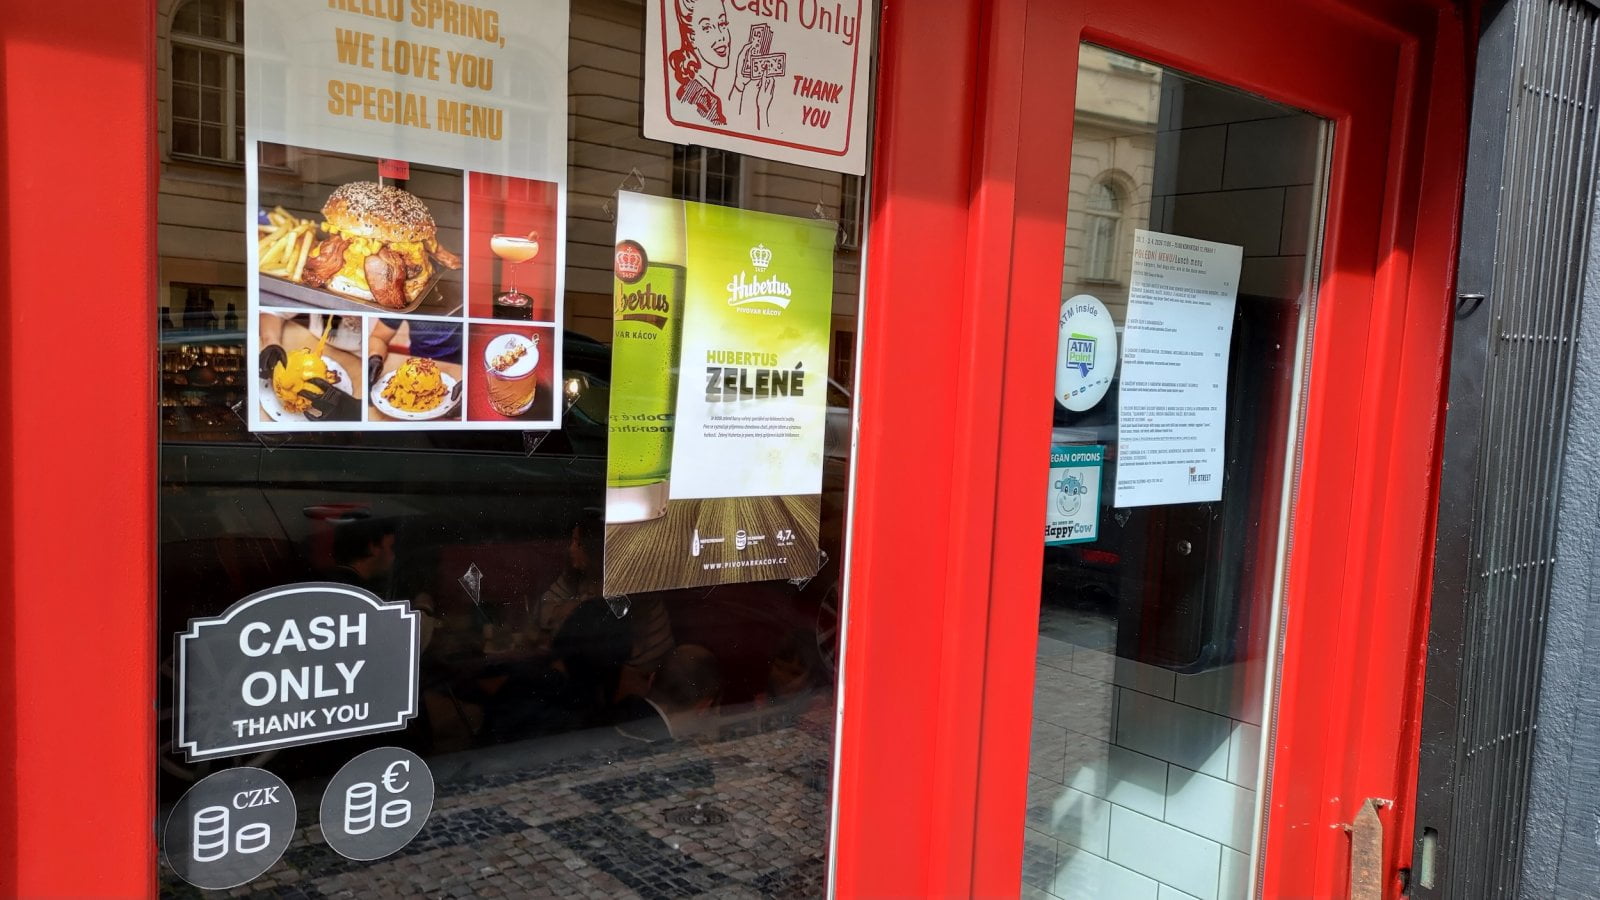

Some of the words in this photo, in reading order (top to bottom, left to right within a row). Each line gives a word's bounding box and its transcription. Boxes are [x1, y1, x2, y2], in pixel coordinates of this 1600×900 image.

[411, 0, 506, 49] SPRING,
[799, 0, 855, 45] Only
[335, 28, 375, 69] WE
[381, 37, 441, 82] LOVE
[447, 51, 494, 91] YOU
[793, 75, 843, 104] THANK
[328, 80, 431, 130] SPECIAL
[438, 99, 504, 141] MENU
[803, 106, 832, 129] YOU
[726, 270, 792, 303] Hubertus
[736, 307, 762, 315] PIVOVAR
[763, 307, 781, 317] KÁCOV
[1059, 306, 1075, 328] ATM
[1076, 303, 1098, 317] inside
[633, 329, 658, 340] KÁCOV
[1070, 341, 1093, 353] ATM
[706, 350, 778, 366] HUBERTUS
[1069, 352, 1091, 362] Point
[705, 361, 805, 397] ZELENÉ
[1050, 453, 1070, 462] EGAN
[1071, 452, 1101, 462] OPTIONS
[703, 557, 788, 570] WWW.PIVOVARKACOV.CZ
[238, 612, 368, 658] CASH
[241, 660, 366, 707] ONLY
[233, 709, 317, 738] THANK
[322, 702, 369, 726] YOU
[232, 785, 281, 811] CZK
